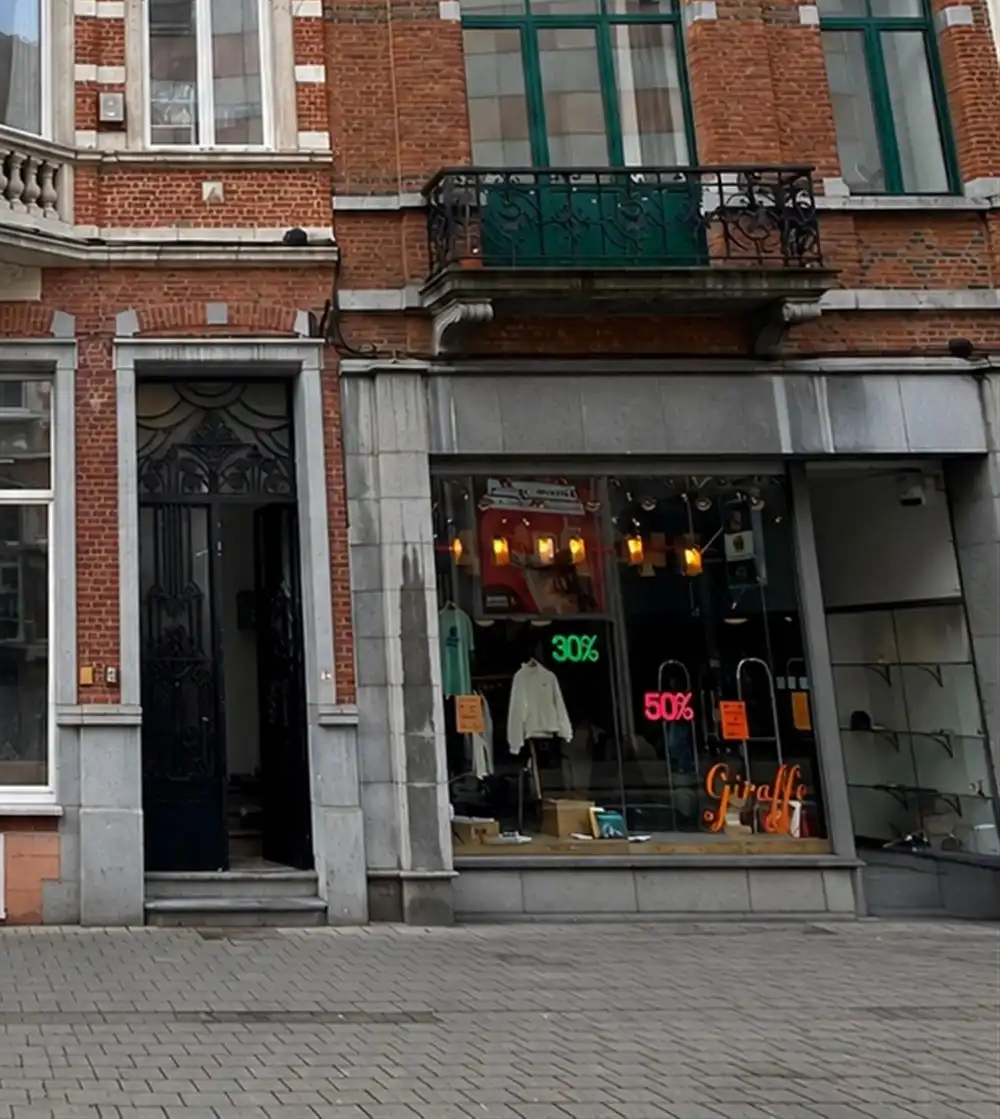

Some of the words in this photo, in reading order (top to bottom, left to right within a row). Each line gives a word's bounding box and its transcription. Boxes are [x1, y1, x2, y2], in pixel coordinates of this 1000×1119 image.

[552, 634, 599, 662] 30%
[644, 691, 694, 721] 50%
[703, 763, 808, 833] Giraffe
